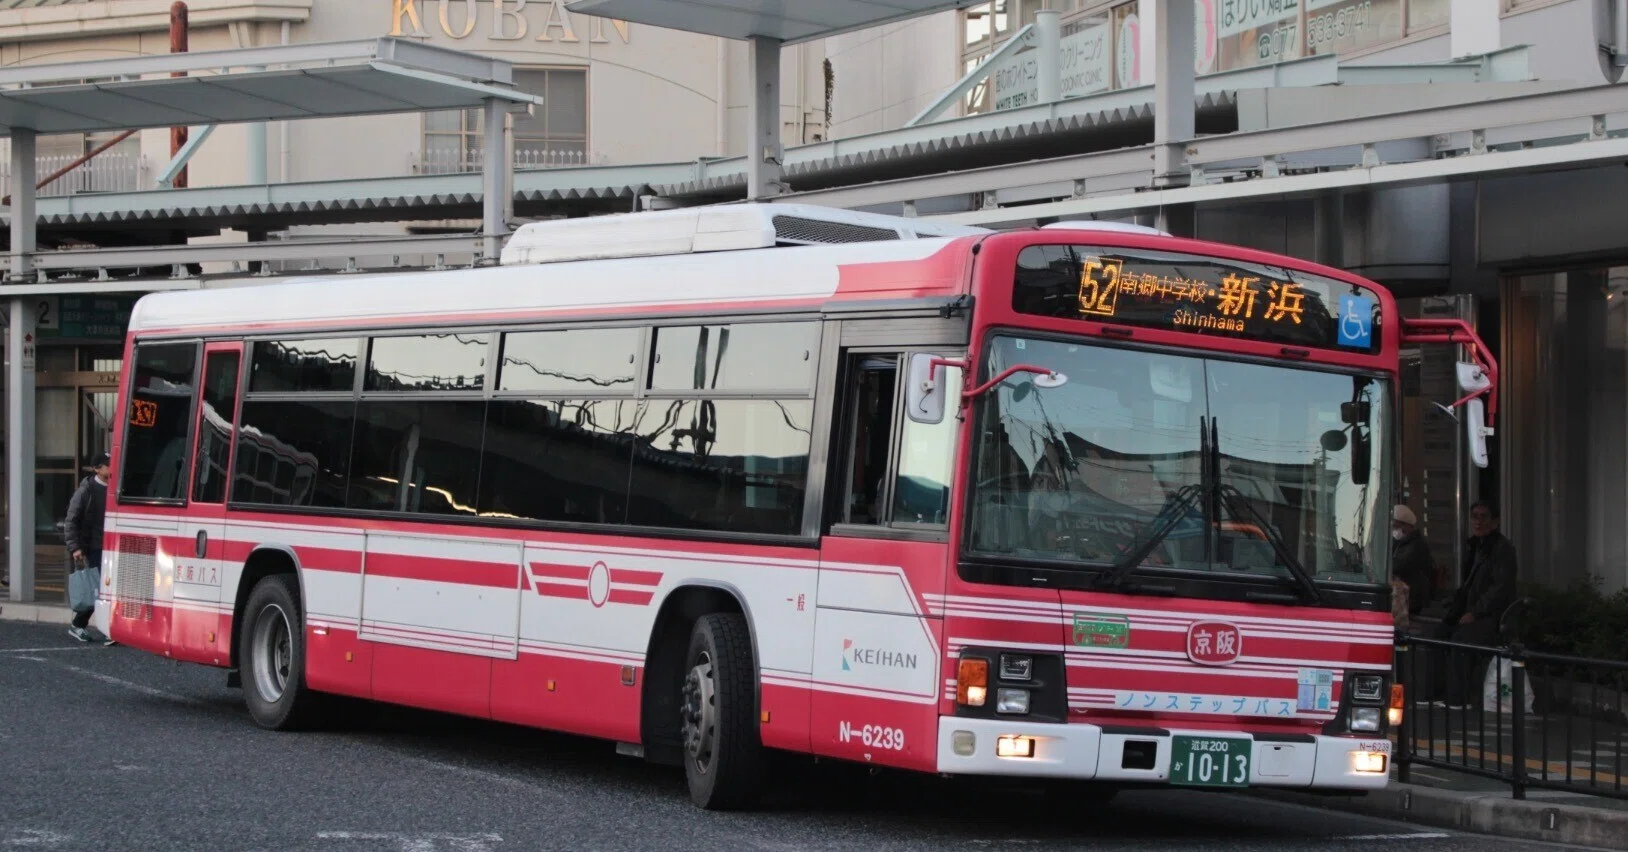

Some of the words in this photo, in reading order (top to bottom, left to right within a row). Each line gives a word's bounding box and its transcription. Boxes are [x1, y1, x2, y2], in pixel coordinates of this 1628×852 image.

[1308, 2, 1371, 47] 533-3741
[1012, 91, 1028, 107] TEETH
[1081, 261, 1119, 311] 52
[38, 301, 50, 324] 2
[1173, 309, 1244, 331] Shinhama
[1194, 629, 1236, 656] 京阪
[854, 648, 918, 669] KEIHAN
[1122, 693, 1294, 716] ノンステップバス
[839, 720, 905, 751] N-6239
[1359, 742, 1390, 753] N-6239
[1187, 752, 1248, 784] 10-13
